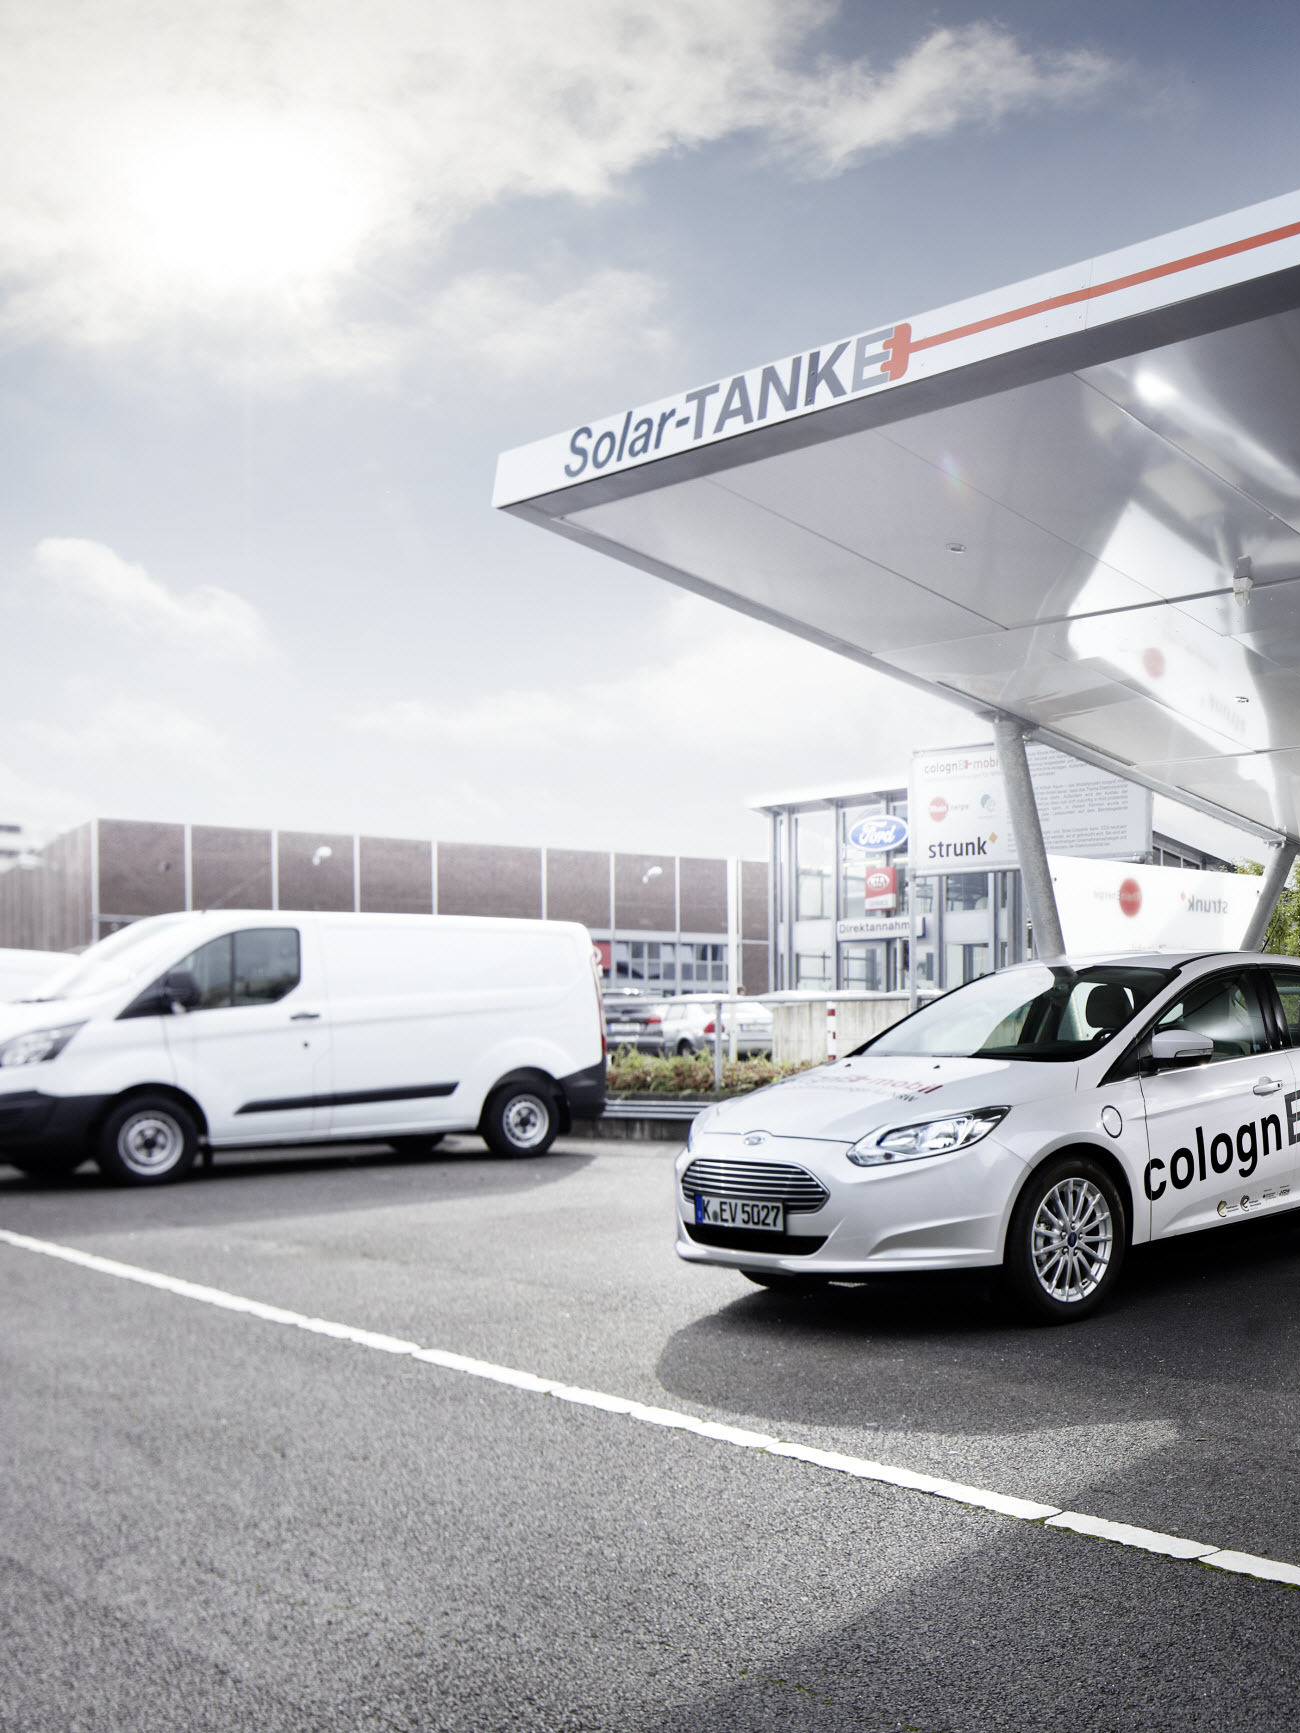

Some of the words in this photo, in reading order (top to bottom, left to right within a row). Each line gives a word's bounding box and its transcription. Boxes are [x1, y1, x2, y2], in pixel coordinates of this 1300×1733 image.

[564, 326, 895, 478] Solar-TANKE
[859, 820, 897, 845] Ford
[928, 837, 987, 858] strunk
[839, 921, 910, 934] Direktannahm
[702, 1199, 711, 1221] K
[719, 1201, 738, 1223] EV
[741, 1203, 780, 1227] 5027
